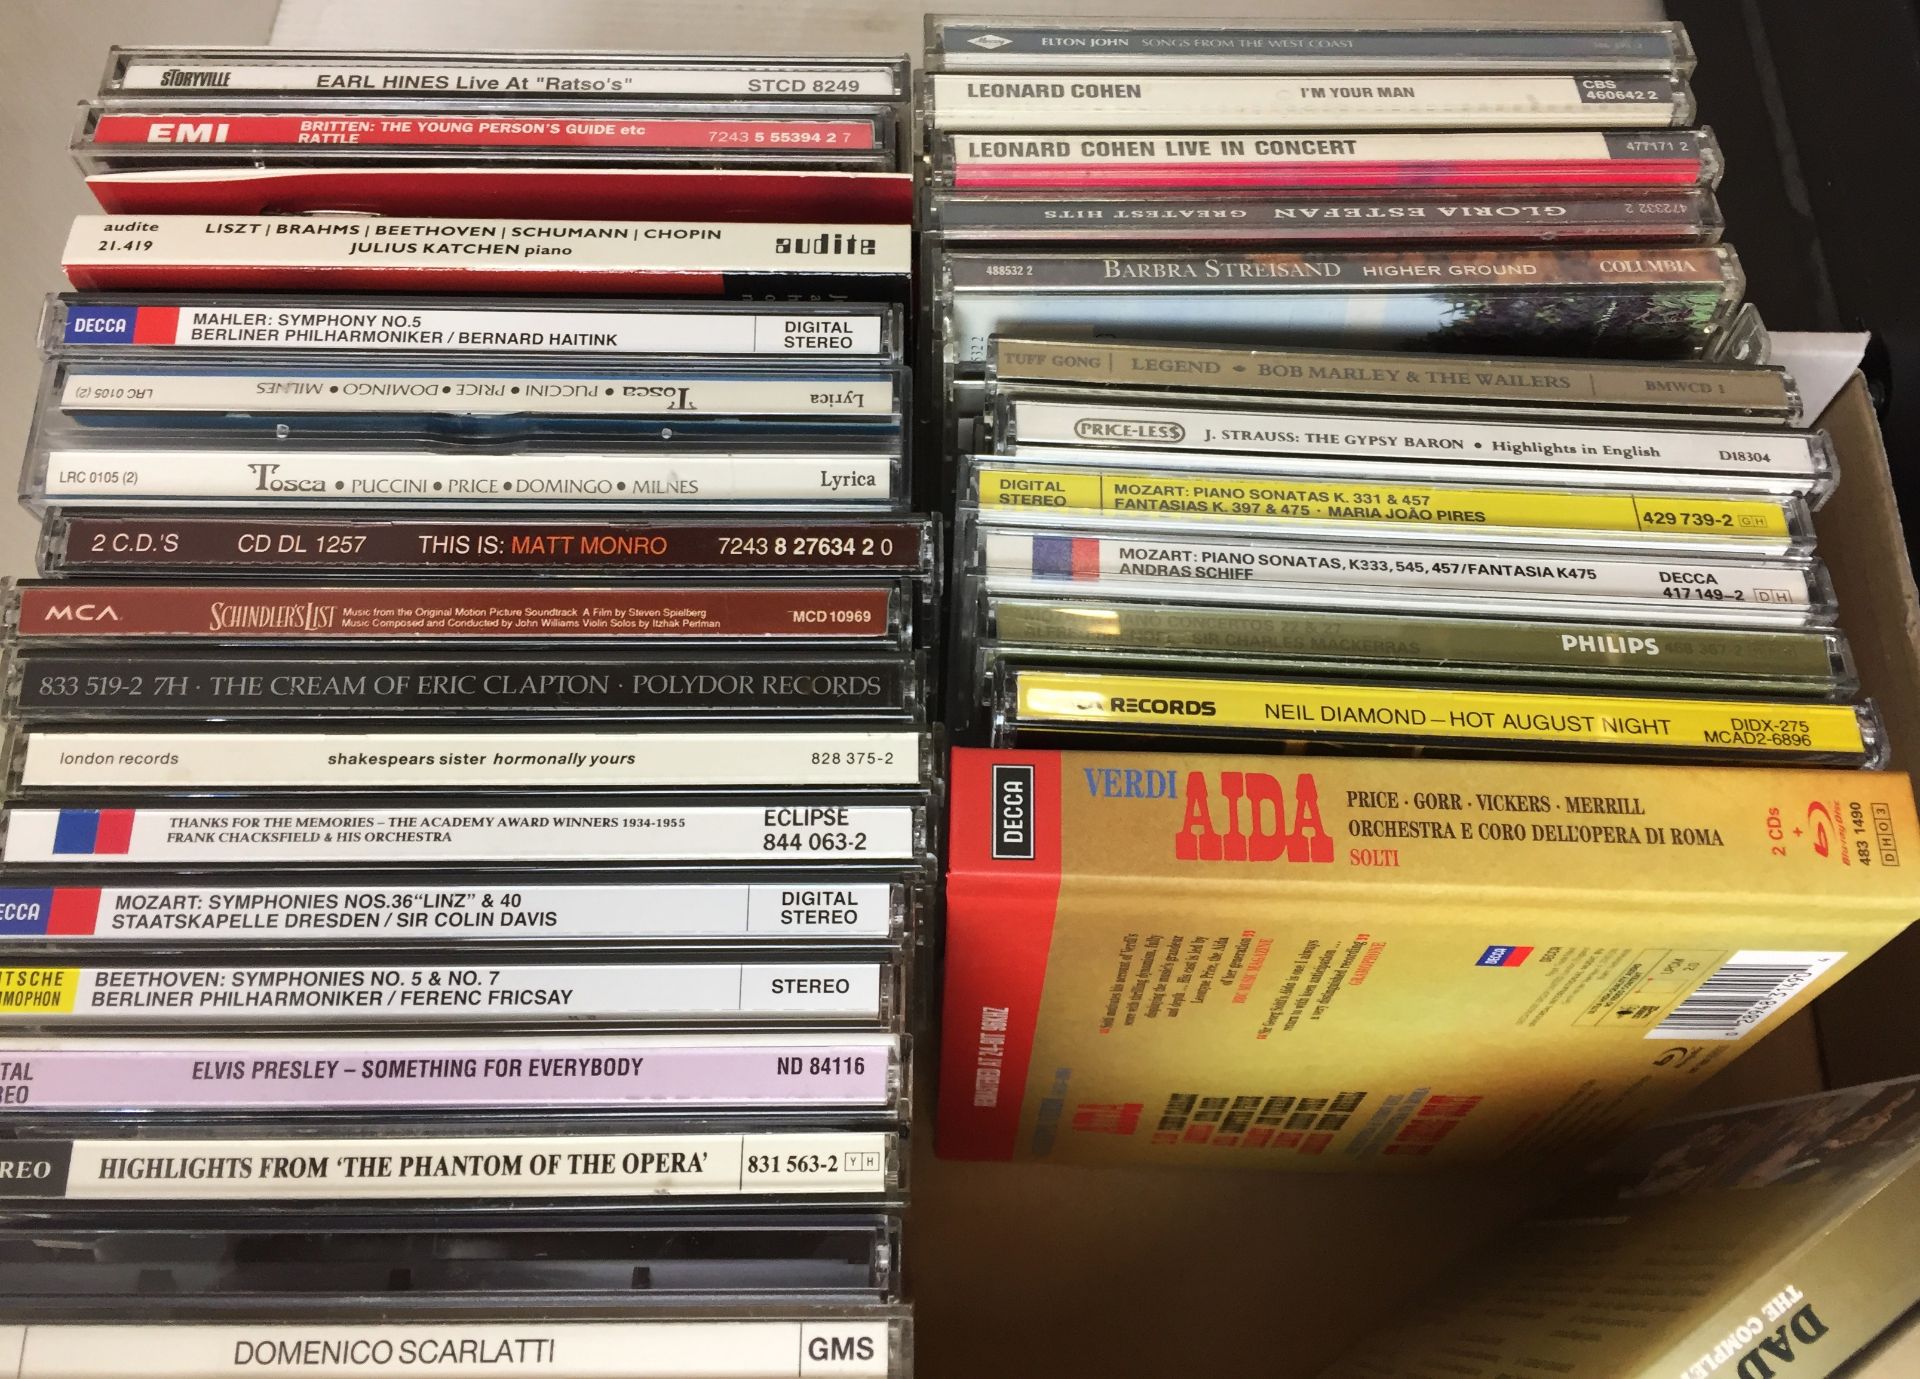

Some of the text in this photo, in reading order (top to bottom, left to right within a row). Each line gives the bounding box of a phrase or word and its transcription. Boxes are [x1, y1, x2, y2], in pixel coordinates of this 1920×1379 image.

[1090, 37, 1129, 47] JOHN
[161, 69, 230, 87] STORYVILLE
[317, 75, 632, 91] EARL HINES "Ratso's"
[1583, 80, 1616, 90] CBS
[748, 79, 859, 93] STCD 8249
[968, 84, 1065, 99] LEONARD
[1330, 87, 1373, 98] YOUR
[1586, 91, 1644, 100] 460642
[147, 124, 229, 142] EMI
[301, 121, 615, 135] BRITTEN: YOUNG PERSON'S GUIDE
[298, 133, 359, 144] RATTLE
[770, 132, 821, 143] 55394
[969, 140, 1357, 158] LEONARD CONCERT
[1626, 140, 1676, 152] 477171
[1114, 206, 1567, 220] GLORIA ESTEFAN GREATEST
[1638, 202, 1688, 214] 472332
[104, 221, 159, 232] audite
[206, 223, 721, 240] LISZT BRAHMS BEETHOVEN SCHUMANN CHOPIN
[98, 240, 153, 251] 21.419
[350, 242, 572, 257] JULIUS KATCHEN piano
[776, 234, 876, 255] audite
[986, 265, 1024, 276] 488532
[1104, 259, 1341, 279] BARBRA STREISAND
[1363, 264, 1537, 276] HIGHER GROUND
[1600, 259, 1696, 274] COLUMBIA
[74, 318, 126, 333] DECCA
[193, 313, 376, 327] MAHLER: SYMPHONY
[785, 322, 853, 334] DIGITAL
[191, 328, 618, 346] BERLINER PHILHARMONIKER BERNARD HAITINK
[784, 335, 853, 348] STEREO
[1476, 372, 1571, 389] WAILERS
[1645, 379, 1713, 394] BMWCD
[93, 388, 123, 398] 0105
[343, 383, 598, 398] PUCCINI DOMINGO
[810, 392, 864, 408] Lyrica
[1222, 430, 1397, 448] STRAUSS: GYPSY
[60, 472, 87, 484] LRC
[821, 471, 876, 489] Lyrica
[1000, 479, 1065, 492] DIGITAL
[352, 479, 698, 495] PUCCINI DOMINGO MILNES
[1114, 484, 1329, 502] MOZART: PIANO SONATAS
[999, 493, 1066, 507] STEREO
[1114, 497, 1486, 523] FANTASIAS MARIA PIRES
[1680, 512, 1734, 527] 739-2
[112, 534, 179, 552] C.D.'S
[316, 536, 366, 553] 1257
[511, 536, 575, 554] MATT
[793, 538, 856, 556] 27634
[1119, 547, 1255, 565] MOZART: PIANO
[1195, 566, 1253, 580] SCHIFF
[1659, 571, 1718, 584] DECCA
[1663, 587, 1694, 600] 417
[45, 605, 118, 621] MCA
[524, 608, 706, 619] Soundtrack Spielberg
[830, 611, 872, 623] 10969
[541, 618, 579, 628] Williams
[1562, 635, 1659, 655] PHILIPS
[484, 675, 881, 697] CLAPTON POLYDOR RECORDS
[1111, 697, 1216, 716] RECORDS
[1321, 705, 1426, 725] DIAMOND
[1731, 718, 1809, 732] DIDX-275
[1704, 731, 1812, 746] MCAD2-6896
[60, 752, 179, 765] london records
[328, 752, 636, 768] shakespears sister hormonally yours
[846, 753, 894, 765] 375-2
[1476, 793, 1645, 815] VICKERS MERRILL
[764, 808, 848, 826] ECLIPSE
[1004, 781, 1023, 844] DECCA
[1175, 771, 1334, 863] AIDA
[1850, 802, 1864, 834] 1490
[170, 817, 685, 828] THANKS MEMORIES ACADEMY AWARD WINNERS 1934-1955
[1348, 819, 1455, 839] ORCHESTRA
[1766, 807, 1784, 841] CDs
[167, 831, 452, 843] FRANK CHACKSFIELD ORCHESTRA
[808, 833, 867, 850] 063-2
[1349, 848, 1400, 867] SOLTI
[115, 895, 338, 910] MOZART: SYMPHONIES
[782, 891, 858, 906] DIGITAL
[0, 903, 40, 921] ECCA
[781, 910, 858, 925] STEREO
[112, 914, 379, 928] STAATSKAPELLE DRESDEN
[1486, 948, 1507, 966] DECCA
[95, 972, 364, 987] BEETHOVEN: SYMPHONIES
[772, 979, 850, 994] STEREO
[92, 990, 573, 1006] BERLINER PHILHARMONIKER FERENC FRICSAY
[192, 1058, 643, 1080] ELVIS PRESLEY SOMETHING EVERYBODY
[810, 1057, 865, 1075] 84116
[99, 1155, 522, 1179] HIGHLIGHTS PHANTOM
[786, 1156, 838, 1173] 563-2
[1761, 1284, 1804, 1322] THE
[234, 1339, 554, 1365] DOMENICO SCARLATTI
[809, 1337, 874, 1360] GMS
